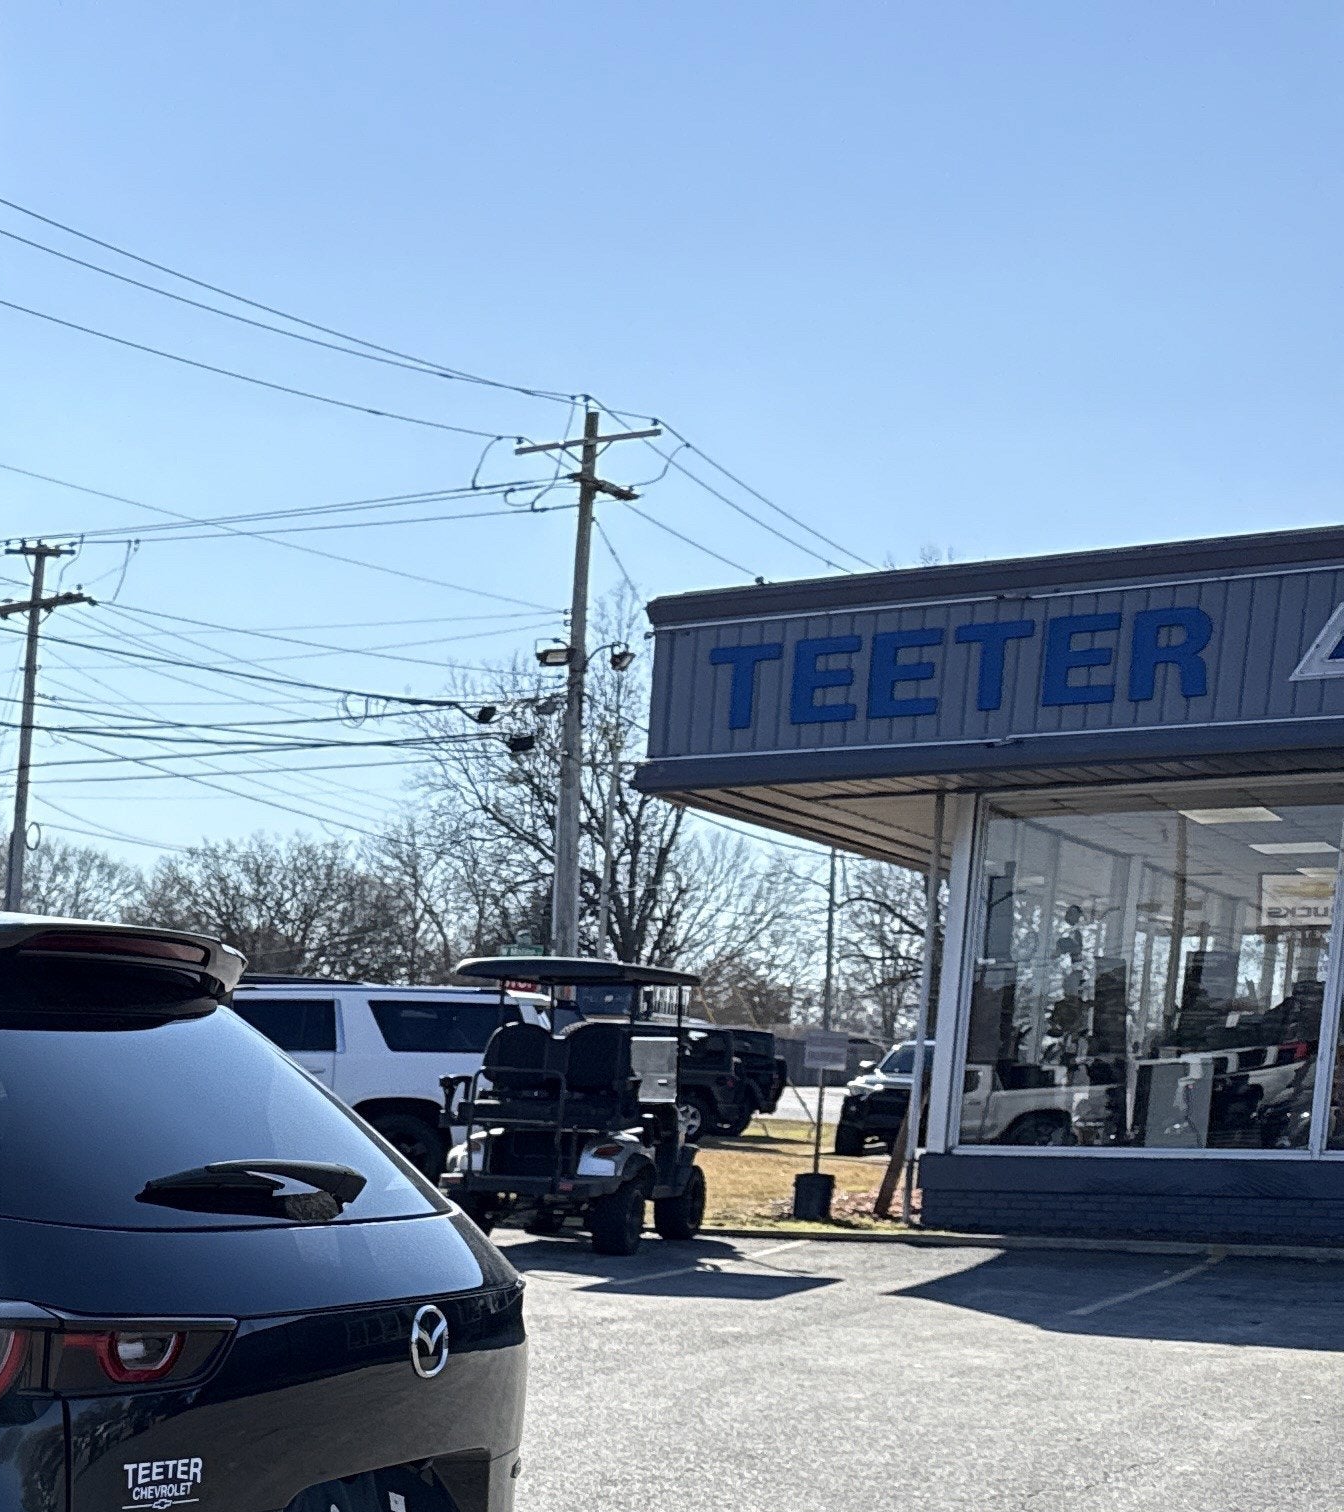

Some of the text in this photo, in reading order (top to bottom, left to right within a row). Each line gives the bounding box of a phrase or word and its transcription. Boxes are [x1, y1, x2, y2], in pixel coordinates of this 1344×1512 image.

[710, 606, 1213, 730] TEETER
[123, 1457, 203, 1489] TEETER
[132, 1481, 193, 1500] CHEVROLET
